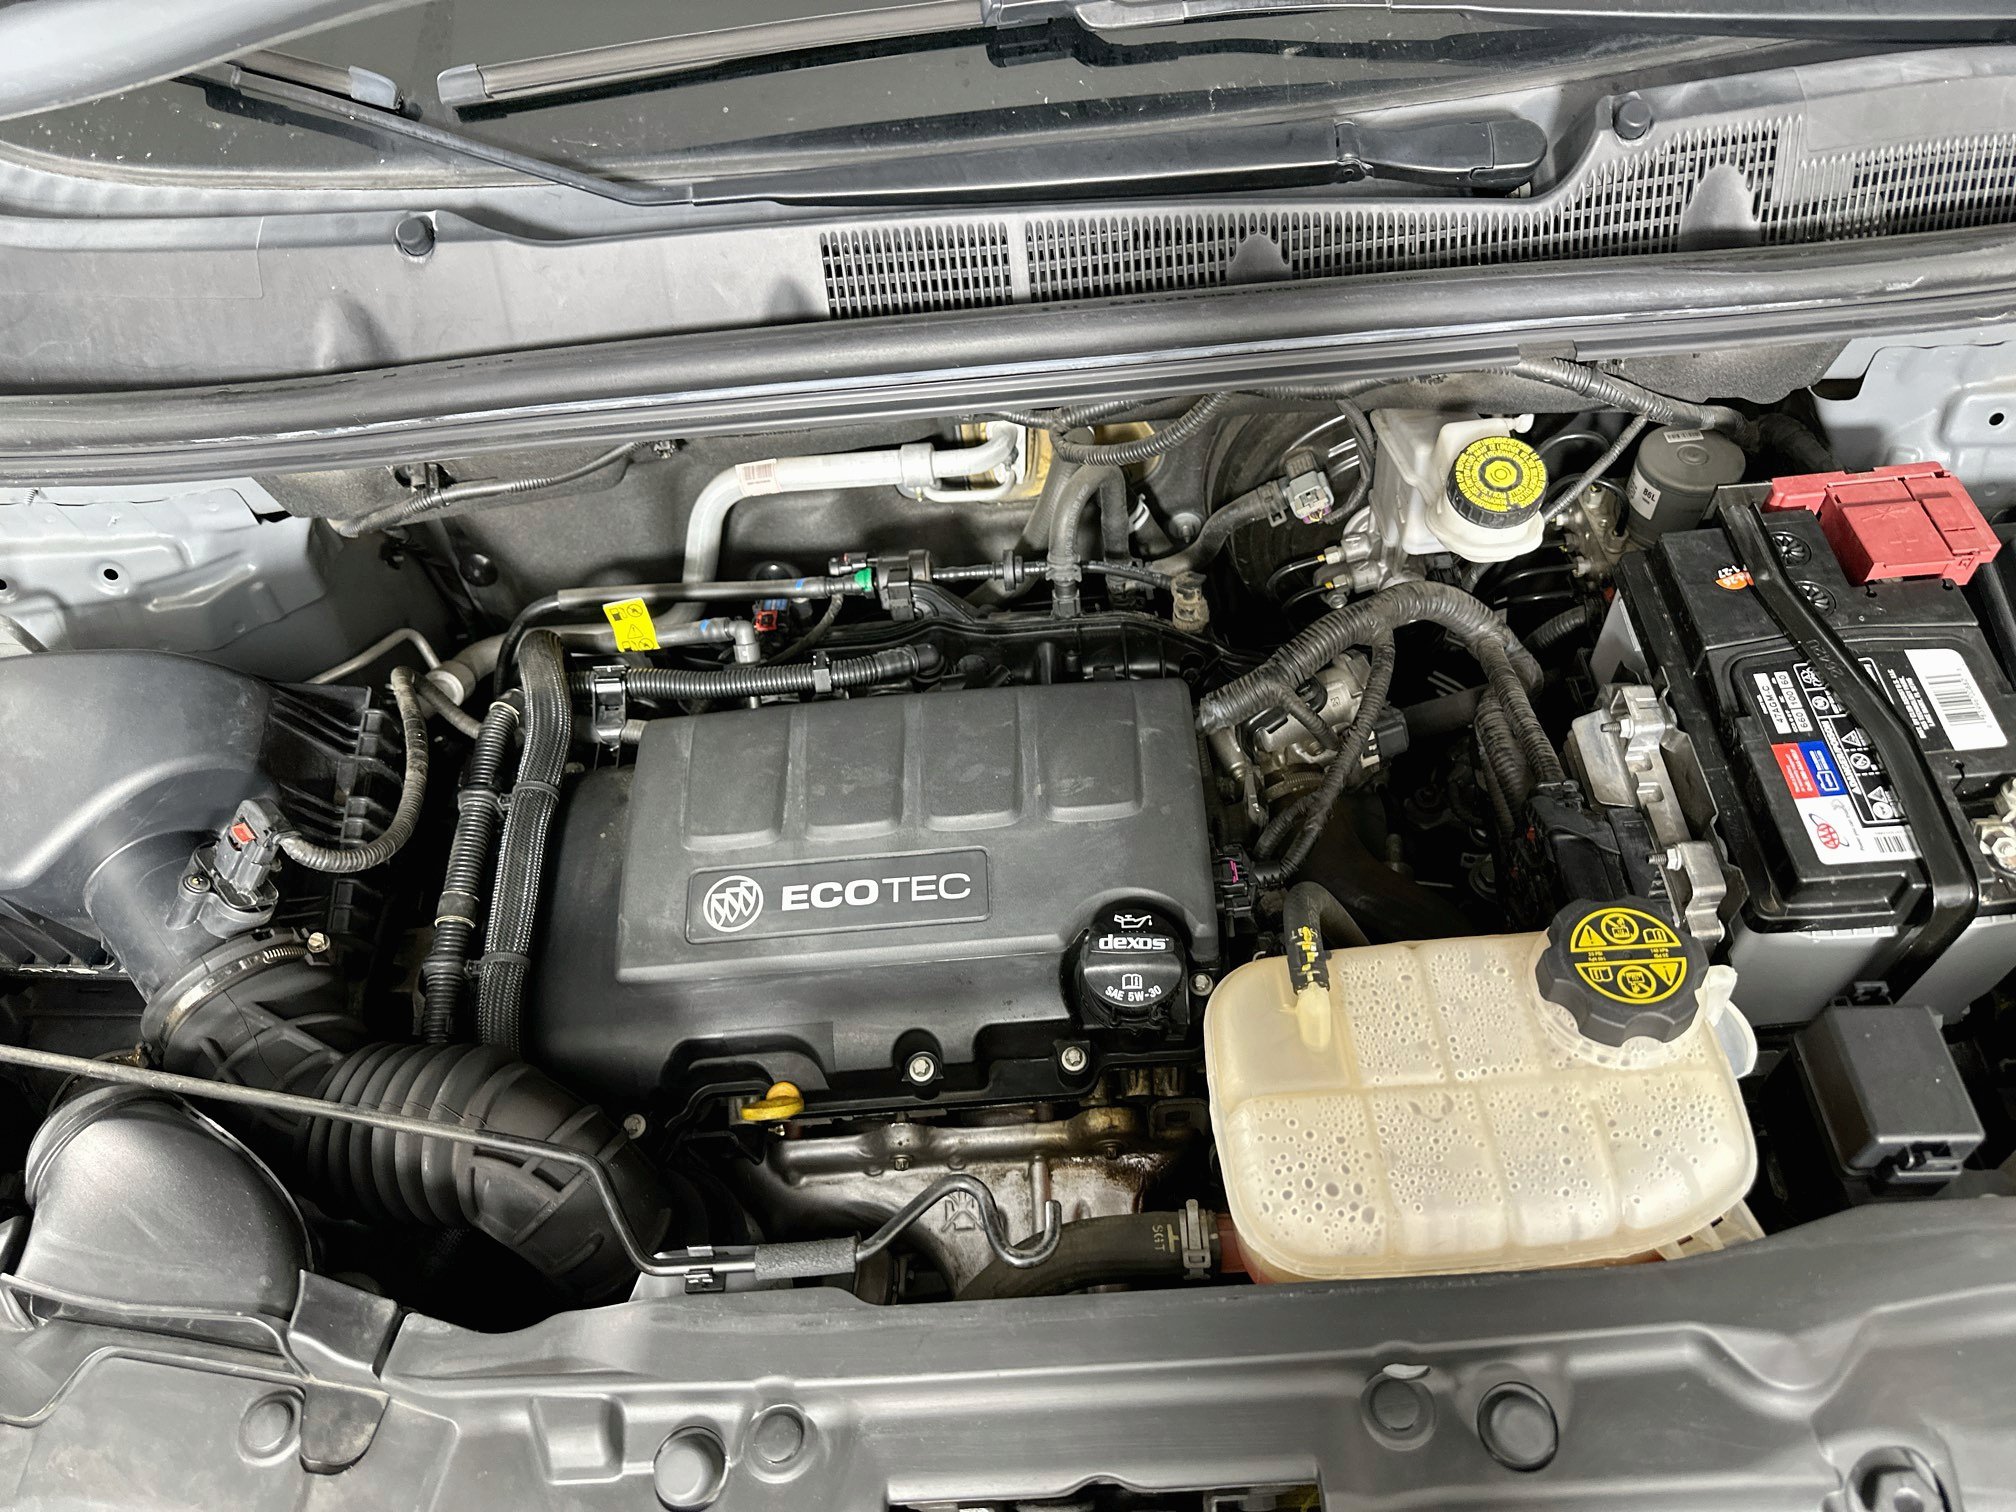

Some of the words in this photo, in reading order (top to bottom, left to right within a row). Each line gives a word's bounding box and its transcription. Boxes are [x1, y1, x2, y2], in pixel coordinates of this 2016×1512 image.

[1643, 487, 1656, 503] B6L
[1779, 674, 1789, 686] 60
[1762, 685, 1784, 723] 47AGM-C
[1786, 690, 1798, 706] 100
[1795, 711, 1809, 729] 660
[1817, 823, 1840, 849] AAA
[780, 872, 972, 912] ECOTEC
[1098, 934, 1166, 950] dexos
[1105, 986, 1125, 1001] SAE
[1128, 985, 1162, 1001] 5W-30
